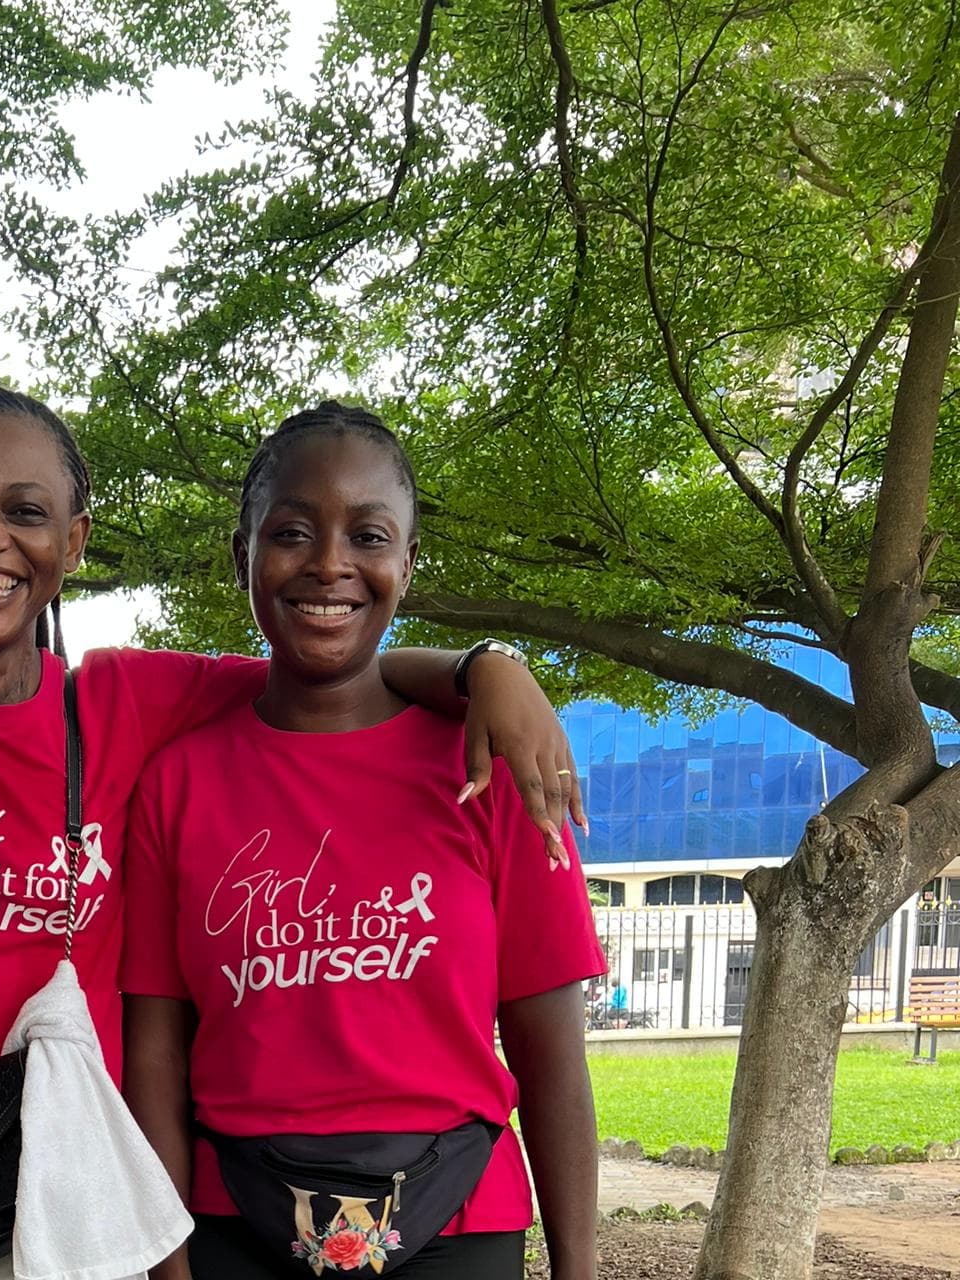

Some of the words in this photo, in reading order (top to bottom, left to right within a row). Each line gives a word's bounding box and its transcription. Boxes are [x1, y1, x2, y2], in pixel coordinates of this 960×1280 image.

[255, 909, 305, 948] do
[313, 908, 341, 943] it
[348, 900, 409, 940] for
[221, 933, 438, 1007] yourself
